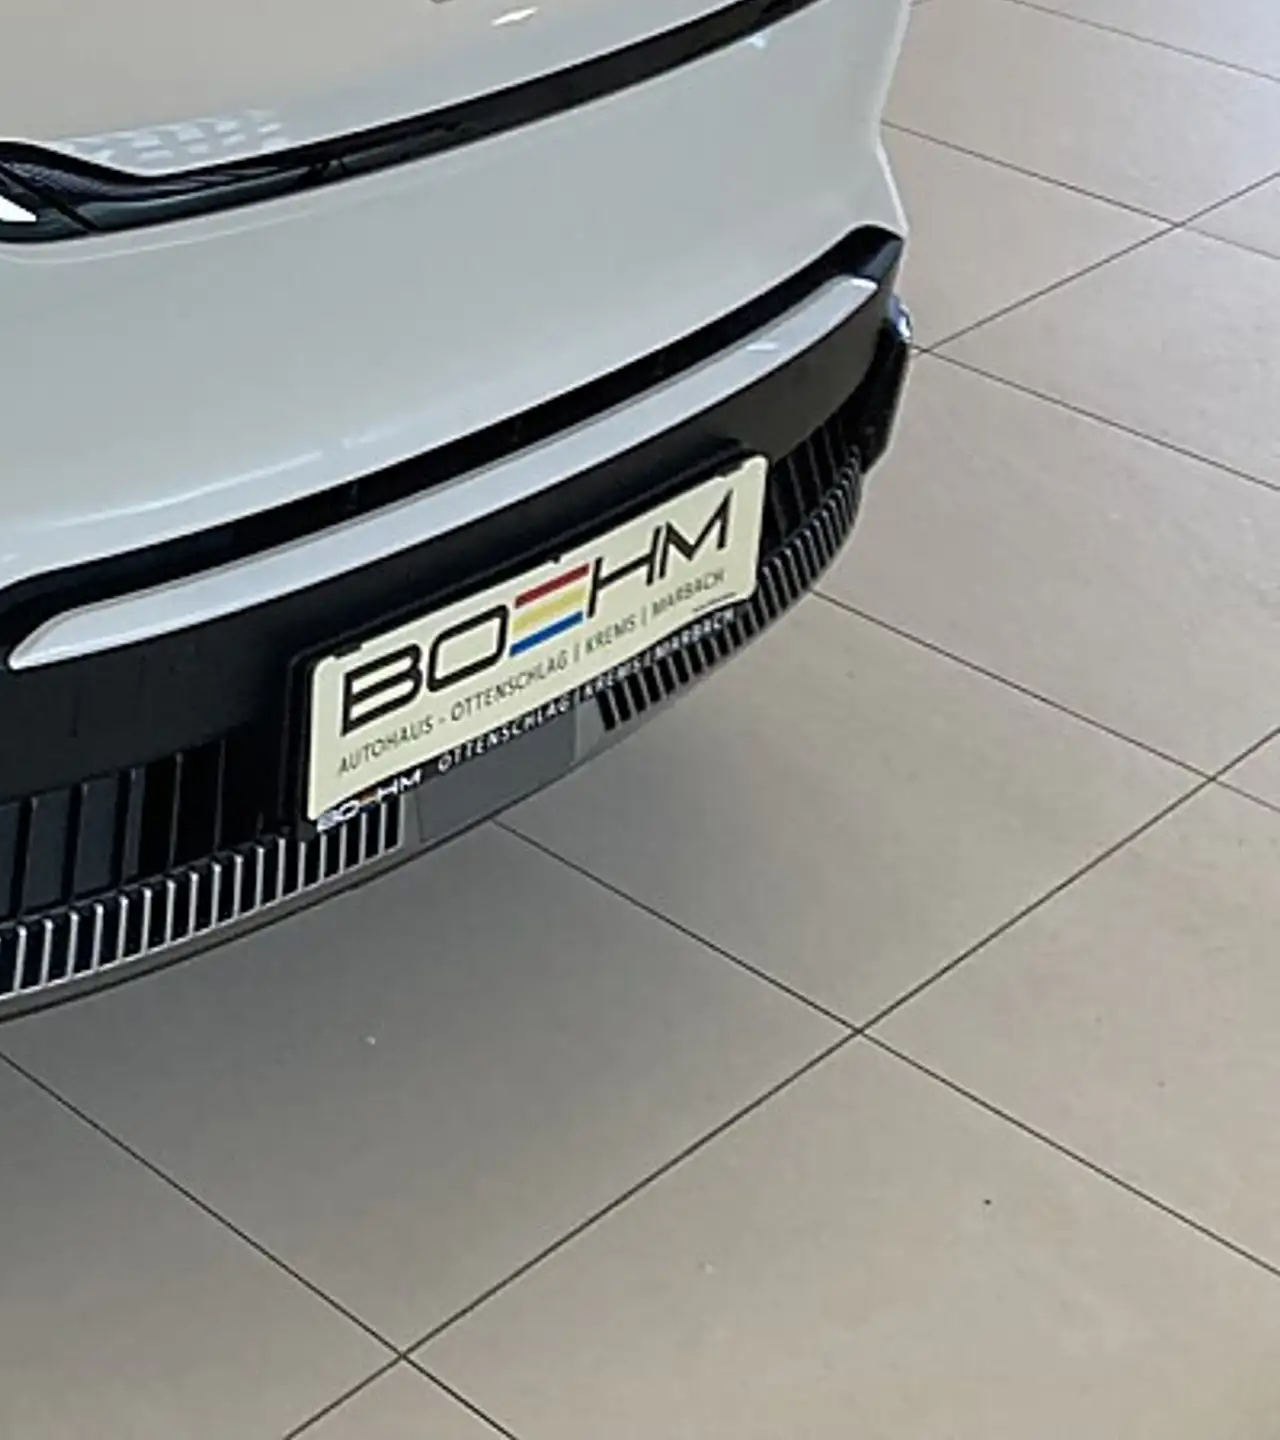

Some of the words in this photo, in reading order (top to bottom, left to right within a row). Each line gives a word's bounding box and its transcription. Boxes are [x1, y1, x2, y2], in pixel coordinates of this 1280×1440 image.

[339, 713, 434, 776] AUTOHAUS
[450, 649, 568, 722] OTTENSCHLAG
[585, 613, 637, 655] KREMS
[652, 567, 725, 615] MARBACH
[437, 695, 569, 773] OTTENSCHLAG
